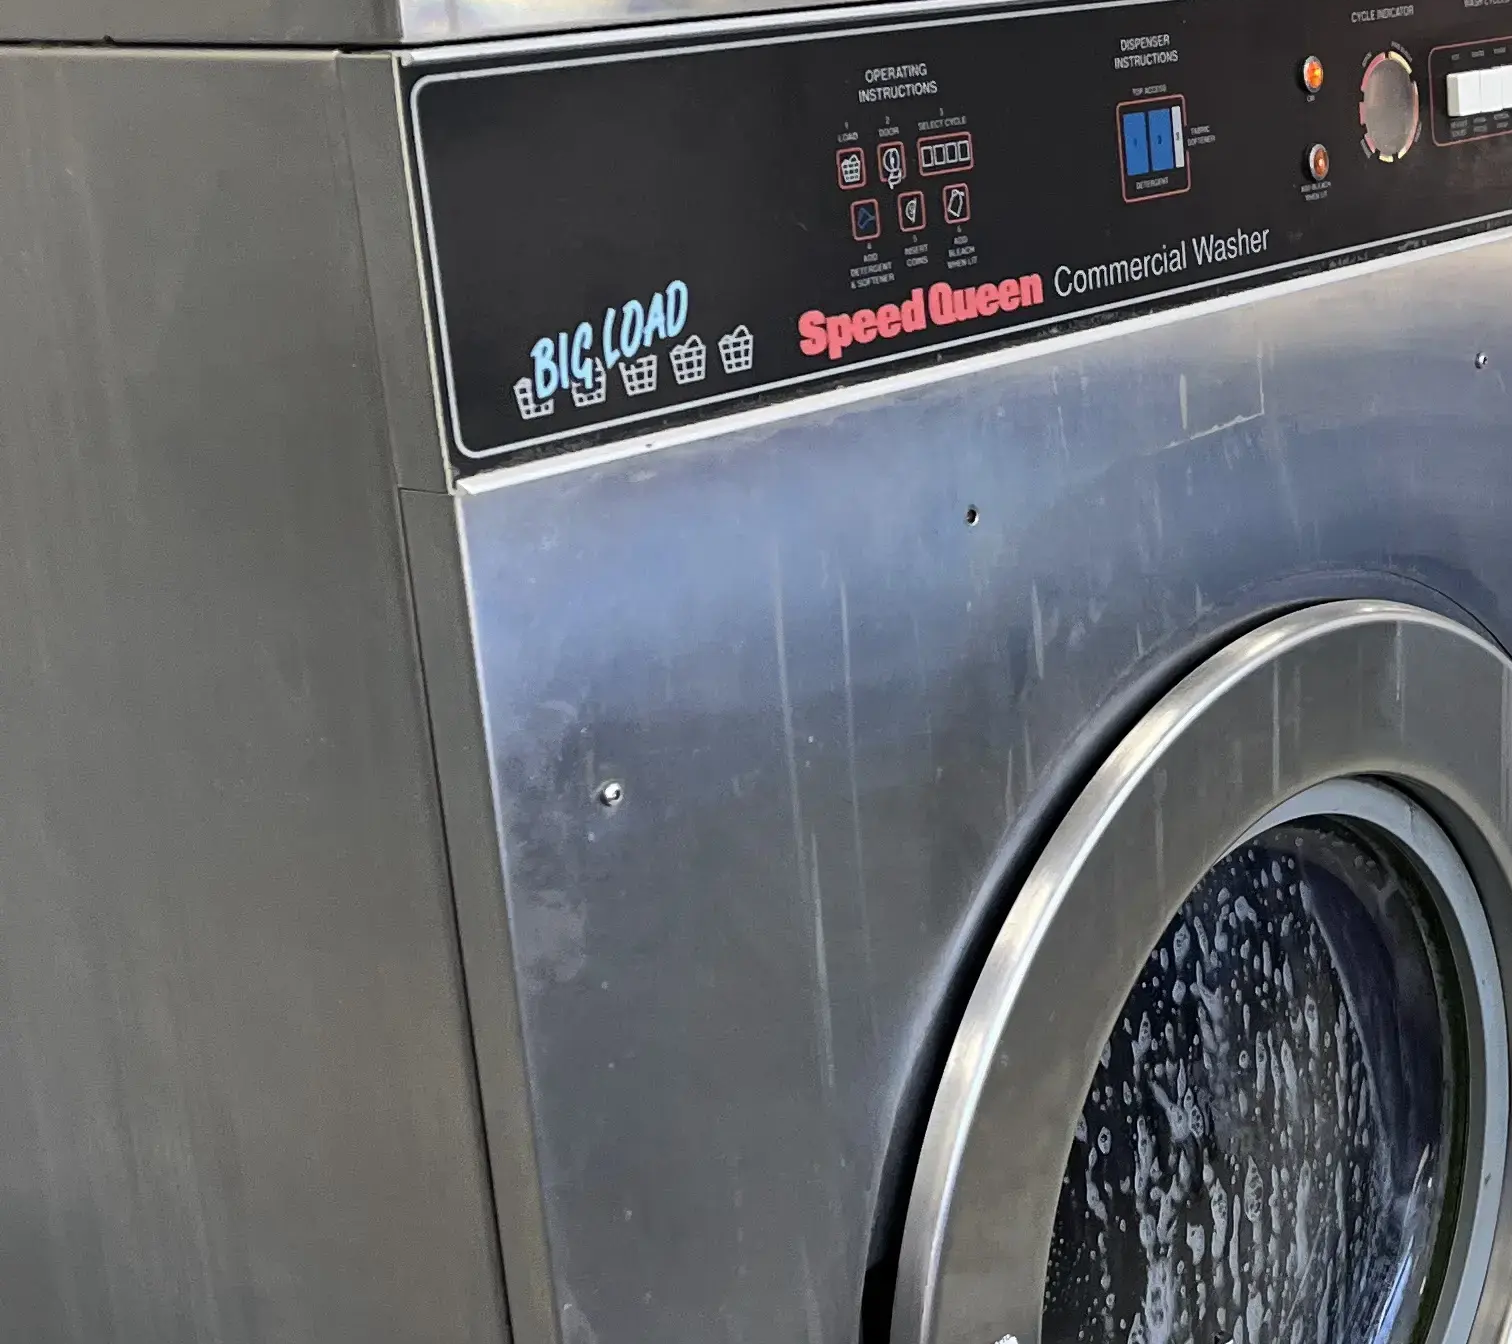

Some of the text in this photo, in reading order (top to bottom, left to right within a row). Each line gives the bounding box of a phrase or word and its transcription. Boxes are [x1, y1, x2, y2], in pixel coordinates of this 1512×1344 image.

[1351, 11, 1376, 24] CYCLE
[1120, 34, 1171, 52] DISPENSER
[1114, 50, 1179, 70] INSTRUCTIONS
[864, 63, 928, 84] OPERATING
[858, 80, 938, 103] INSTRUCTIONS
[799, 225, 1270, 359] Speed Queen Commercial Washer
[531, 280, 689, 400] BIG LOAD
